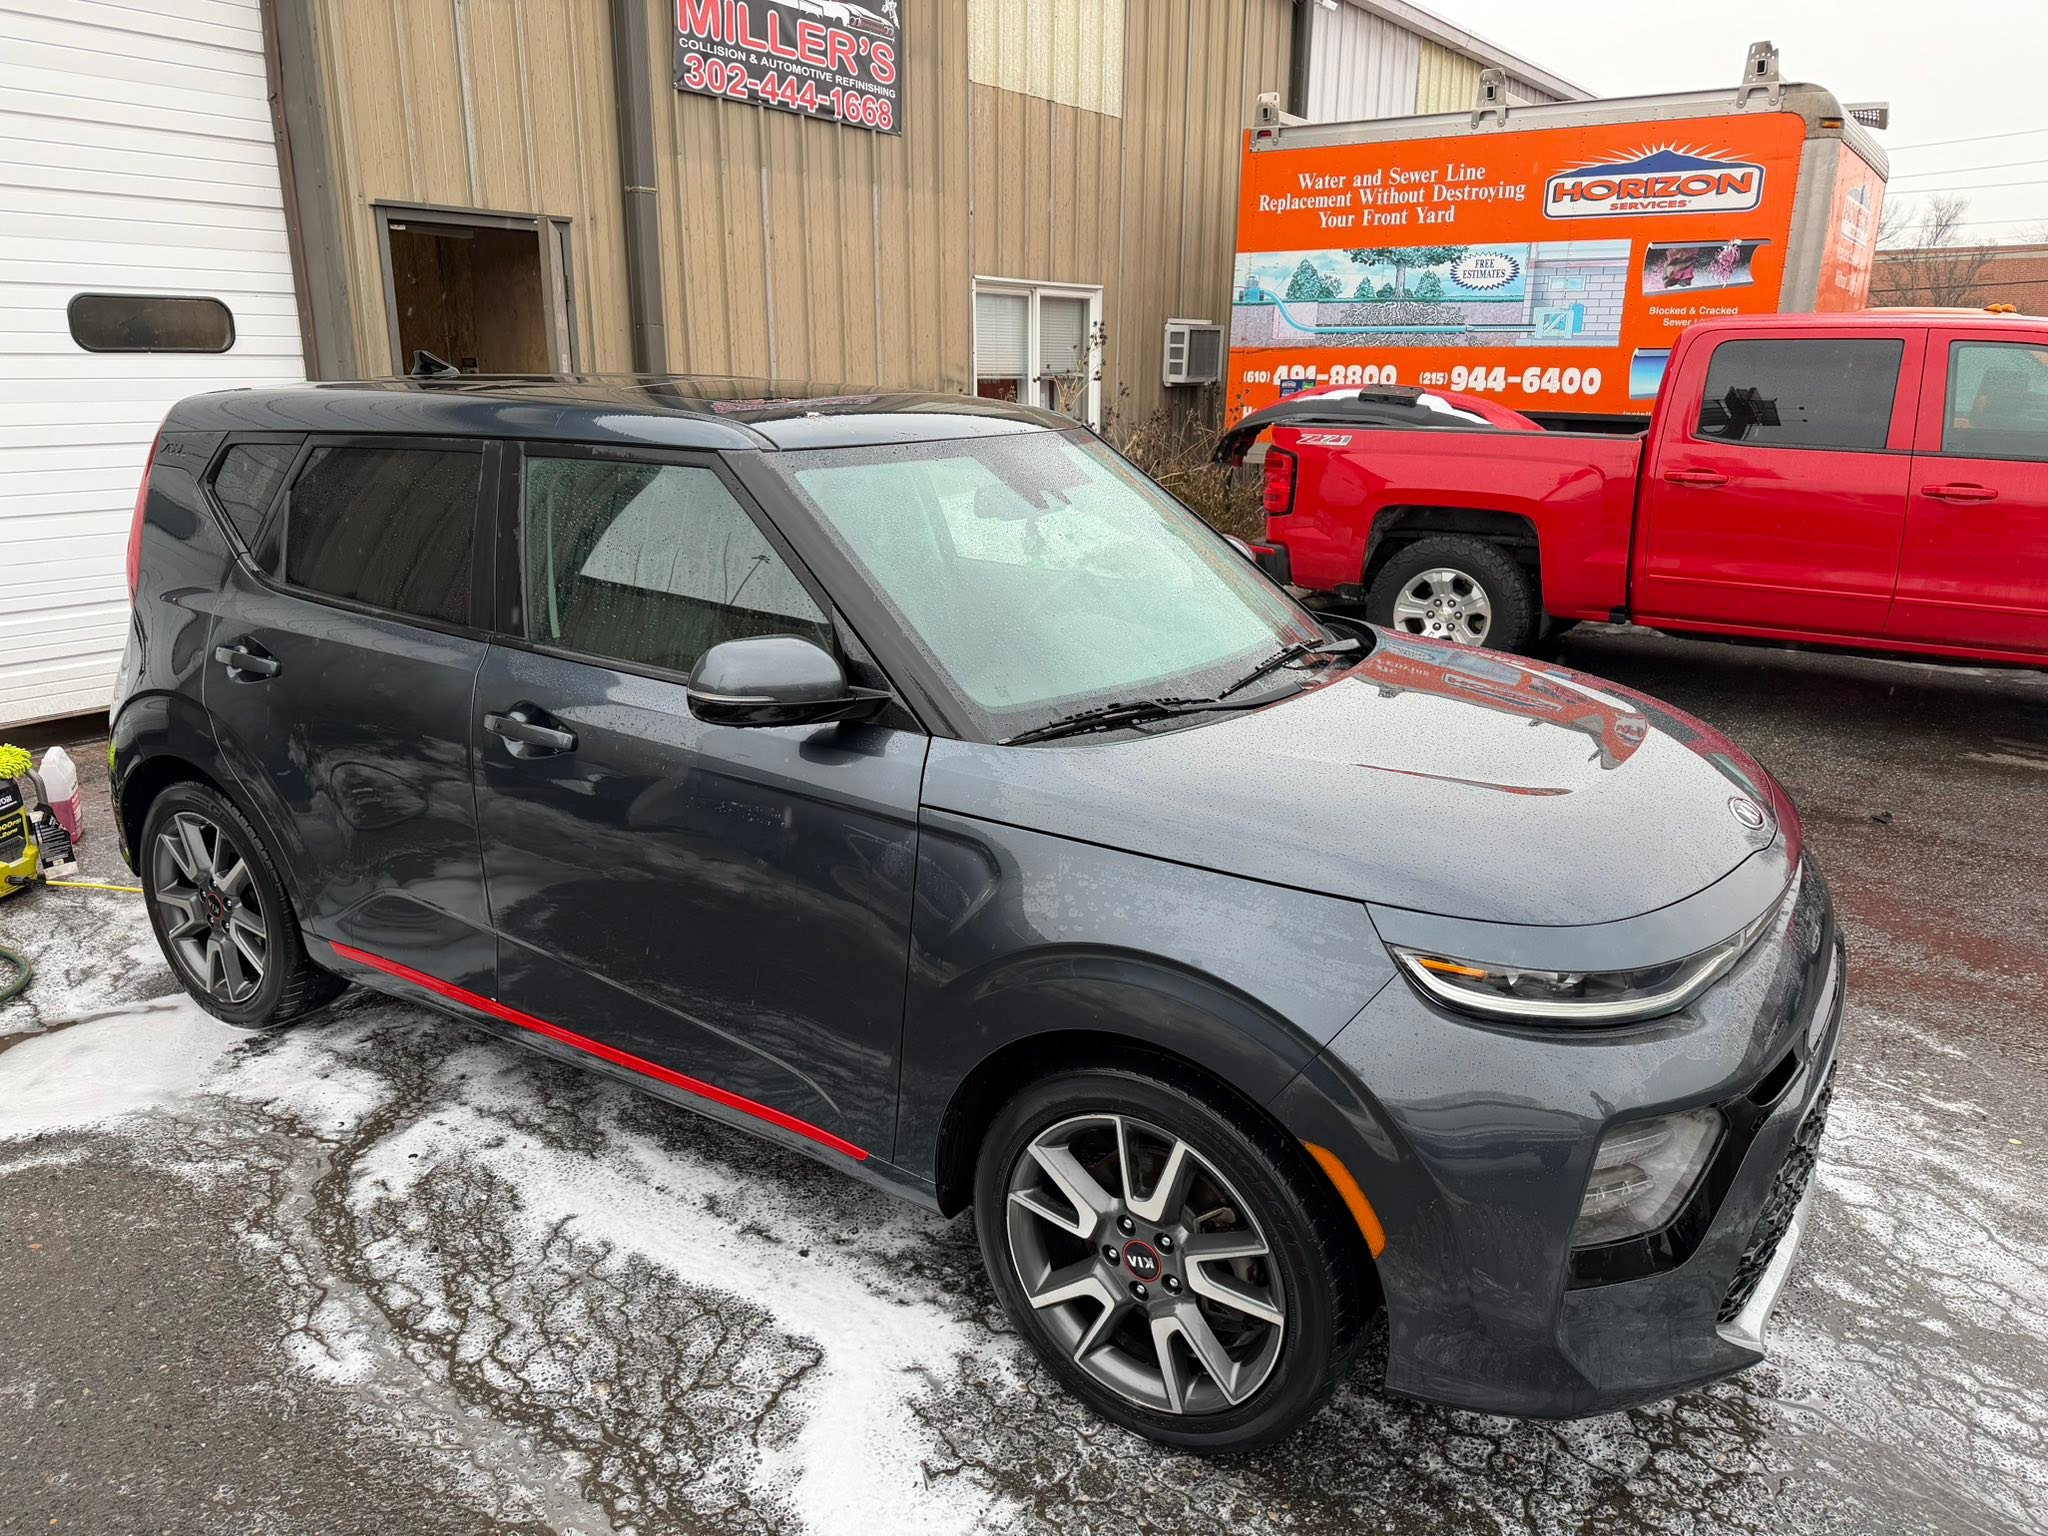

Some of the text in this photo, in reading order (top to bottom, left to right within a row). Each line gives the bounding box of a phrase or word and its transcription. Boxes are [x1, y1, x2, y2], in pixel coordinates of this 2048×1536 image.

[677, 0, 897, 84] MILLER'S
[679, 37, 896, 99] COLLISION & AUTOMOTIVE REFINISHING
[683, 53, 893, 130] 302-444-1668
[1298, 163, 1486, 190] Water and Sewer Line
[1552, 171, 1754, 203] HORIZON
[1258, 181, 1526, 214] Replacement Without Destroying
[1609, 200, 1688, 211] SERVICES
[1318, 204, 1455, 228] Your Front Yard
[1462, 269, 1506, 279] ESTIMATES
[1475, 259, 1495, 269] FREE
[1649, 306, 1738, 315] Blocked & Cracked
[1663, 318, 1691, 326] Sewer
[1243, 371, 1270, 383] (610)
[1419, 365, 1602, 395] (215) 944-6400
[1127, 1255, 1155, 1269] KIA
